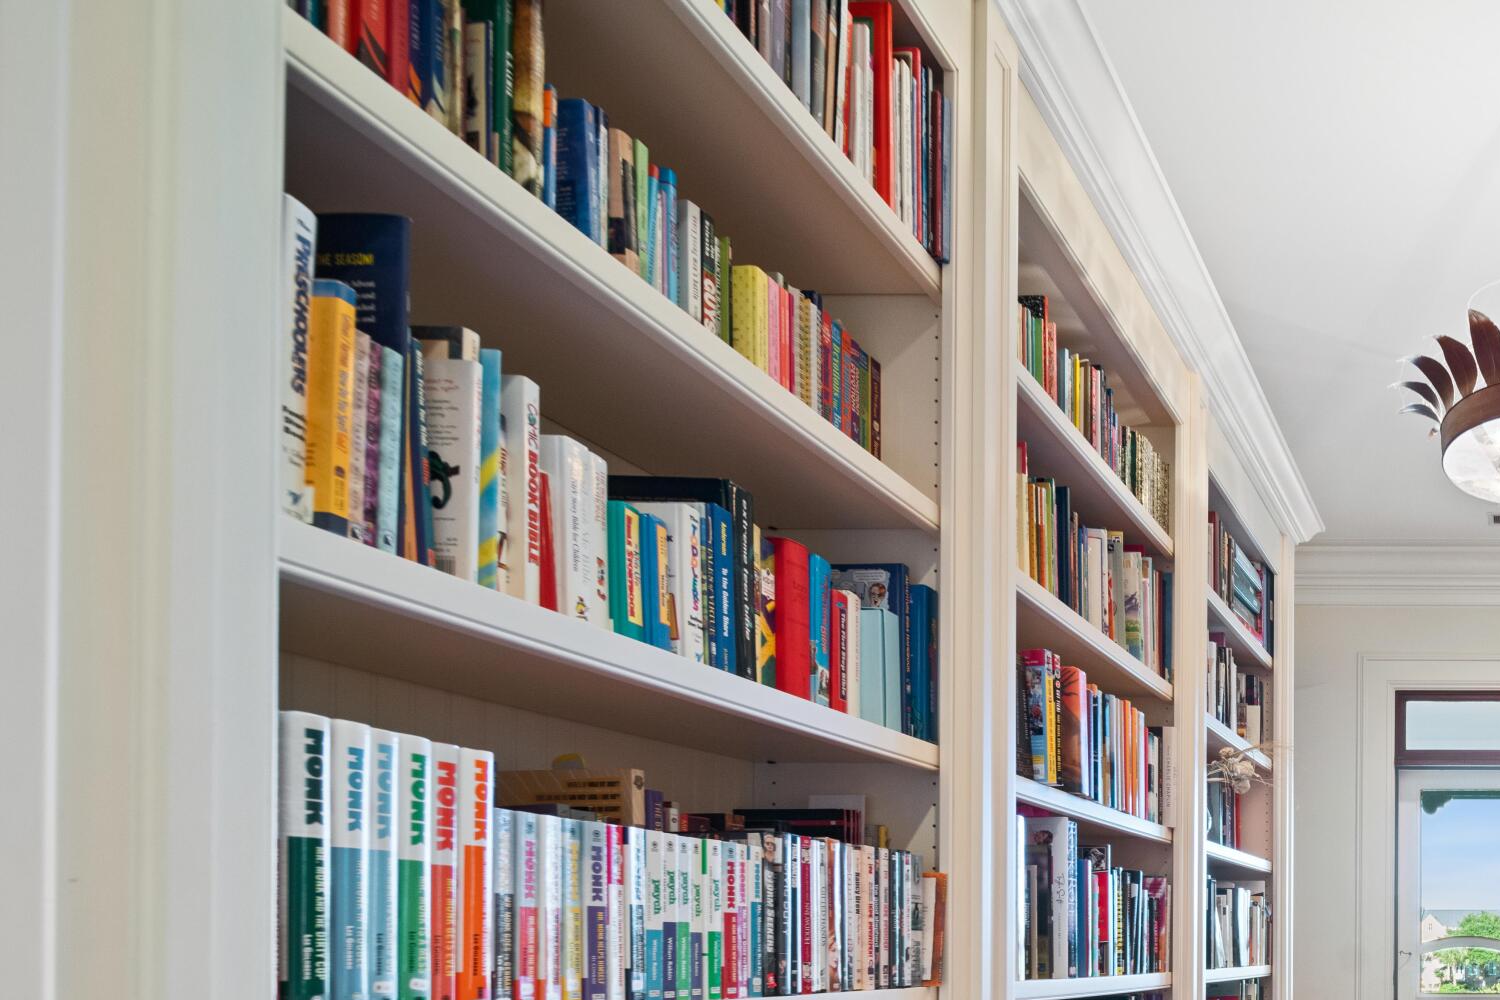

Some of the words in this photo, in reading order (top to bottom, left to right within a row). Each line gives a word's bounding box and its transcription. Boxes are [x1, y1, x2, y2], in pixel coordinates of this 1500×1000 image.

[291, 232, 312, 396] PRESCHOOLERS
[529, 450, 540, 508] BOOK
[528, 509, 541, 568] BIBLE
[722, 567, 728, 577] To
[840, 651, 848, 671] Step
[304, 728, 325, 826] MONK
[347, 747, 365, 832] MONK
[377, 744, 393, 839] MONK
[411, 754, 427, 846] MONK
[474, 760, 489, 841] MONK
[436, 762, 457, 852] MONK
[525, 840, 537, 899] MONK
[592, 846, 603, 902] MONK
[652, 879, 662, 915] psych
[667, 870, 677, 905] psych
[681, 871, 689, 905] psych
[713, 879, 722, 912] psych
[727, 861, 736, 909] MONK
[694, 884, 703, 917] psych
